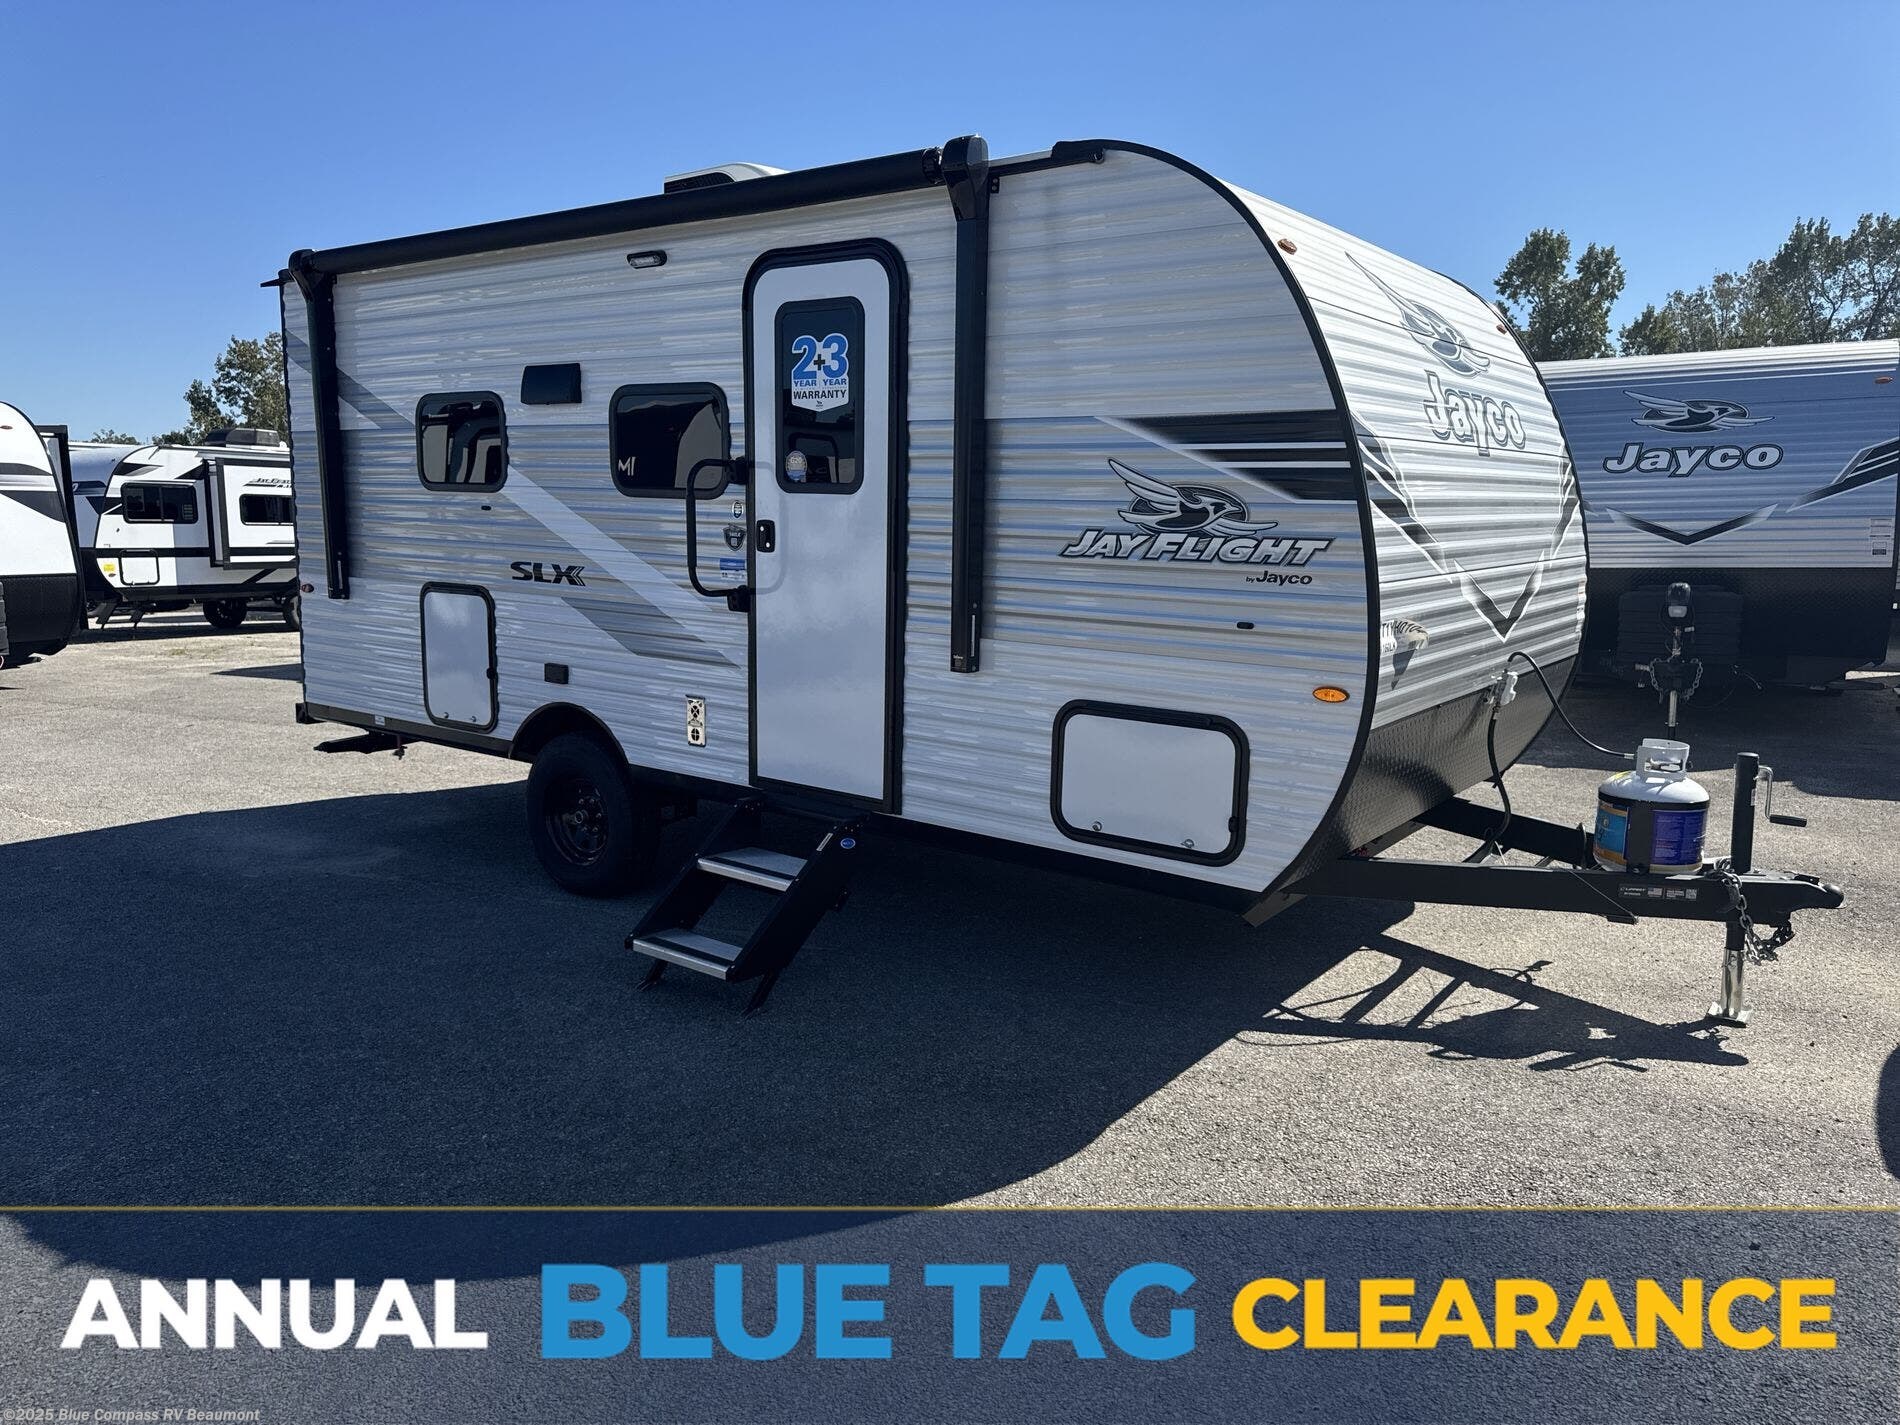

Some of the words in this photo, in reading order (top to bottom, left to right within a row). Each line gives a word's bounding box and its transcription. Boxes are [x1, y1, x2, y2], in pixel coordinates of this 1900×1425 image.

[793, 379, 817, 387] YEAR
[822, 378, 847, 386] YEAR
[793, 390, 847, 400] WARRANTY
[1423, 369, 1526, 457] Jayco
[1603, 442, 1784, 477] Jayco
[1058, 527, 1153, 558] JAY
[1145, 531, 1336, 567] FLIGHT
[510, 561, 586, 587] SLX
[1245, 575, 1255, 584] by
[1256, 570, 1313, 587] Jayco
